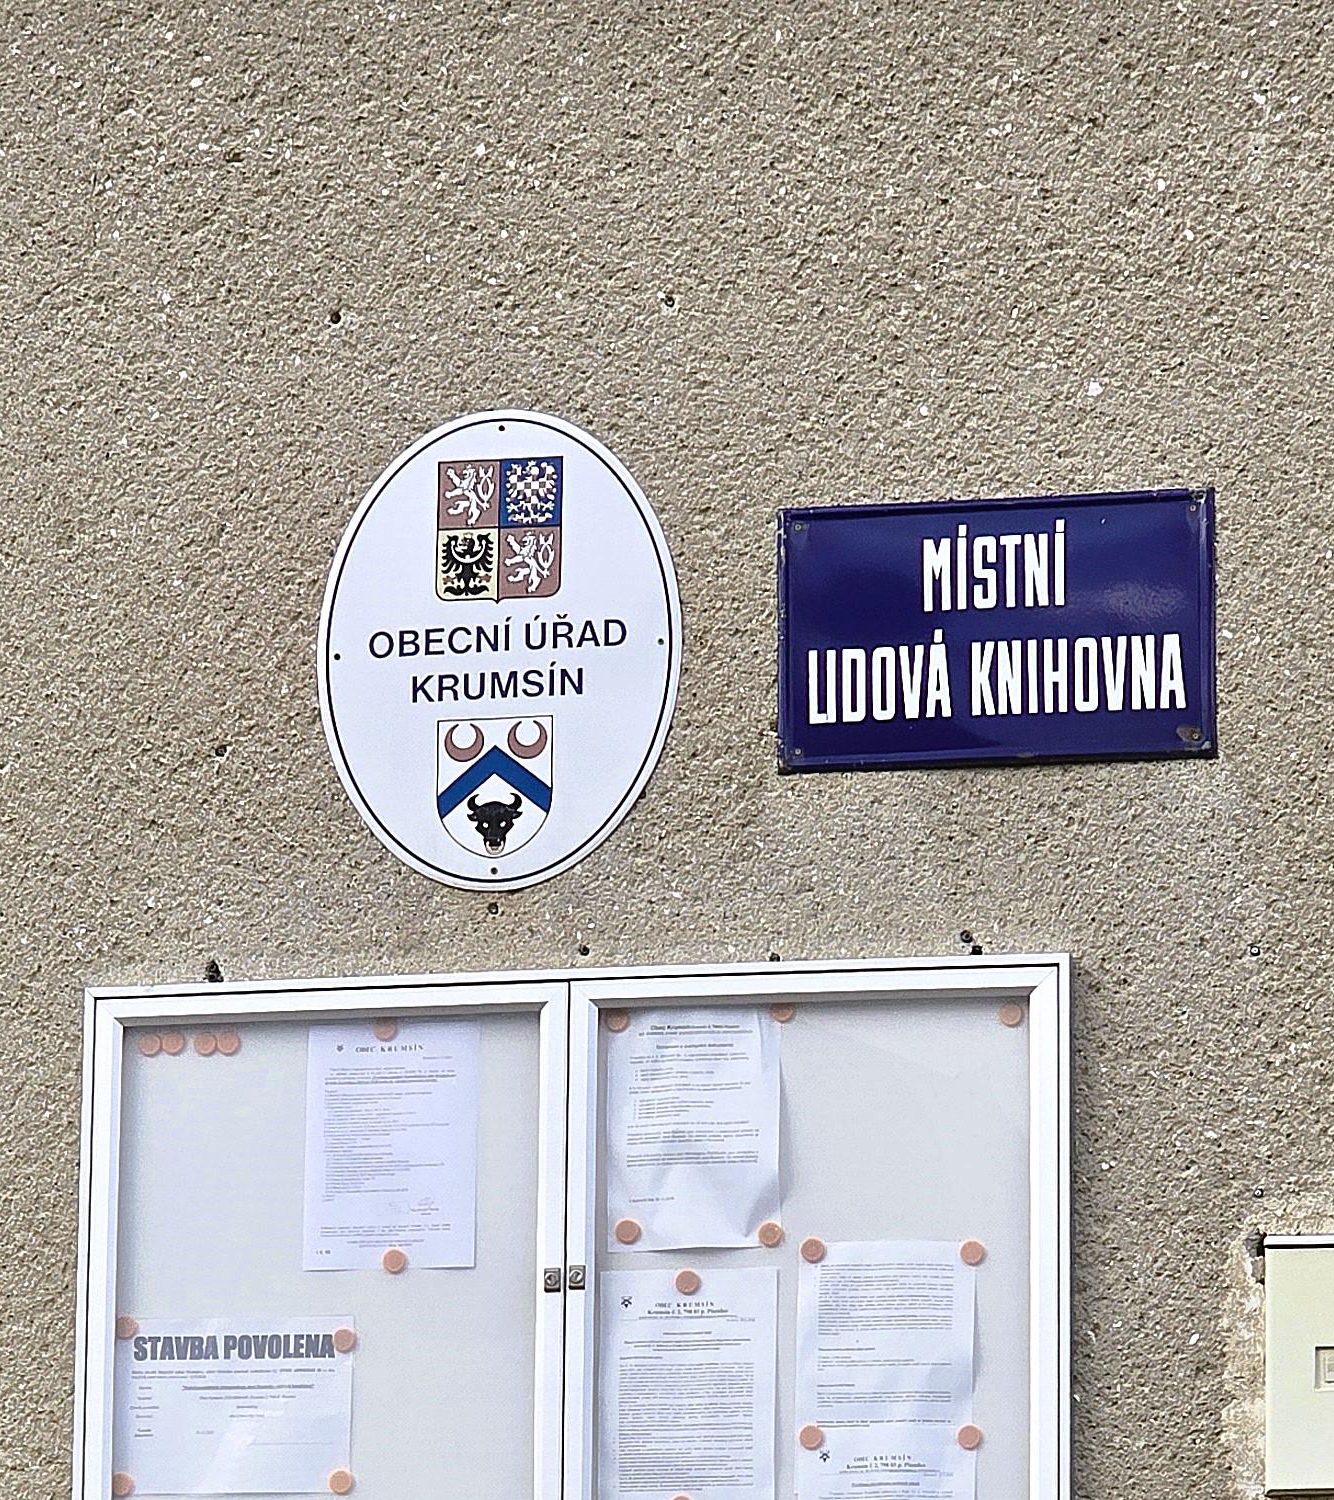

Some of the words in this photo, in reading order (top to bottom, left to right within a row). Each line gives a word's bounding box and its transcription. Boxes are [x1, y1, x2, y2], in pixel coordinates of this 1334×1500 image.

[922, 518, 1066, 612] MÍSTNÍ
[368, 616, 513, 659] OBECNÍ
[524, 614, 627, 650] ÚŘAD
[411, 661, 584, 703] KRUMSÍN
[807, 628, 952, 725] LIDOVÁ
[971, 633, 1187, 716] KNIHOVNA
[133, 1336, 219, 1362] STAVBA
[224, 1334, 336, 1360] POVOLENA
